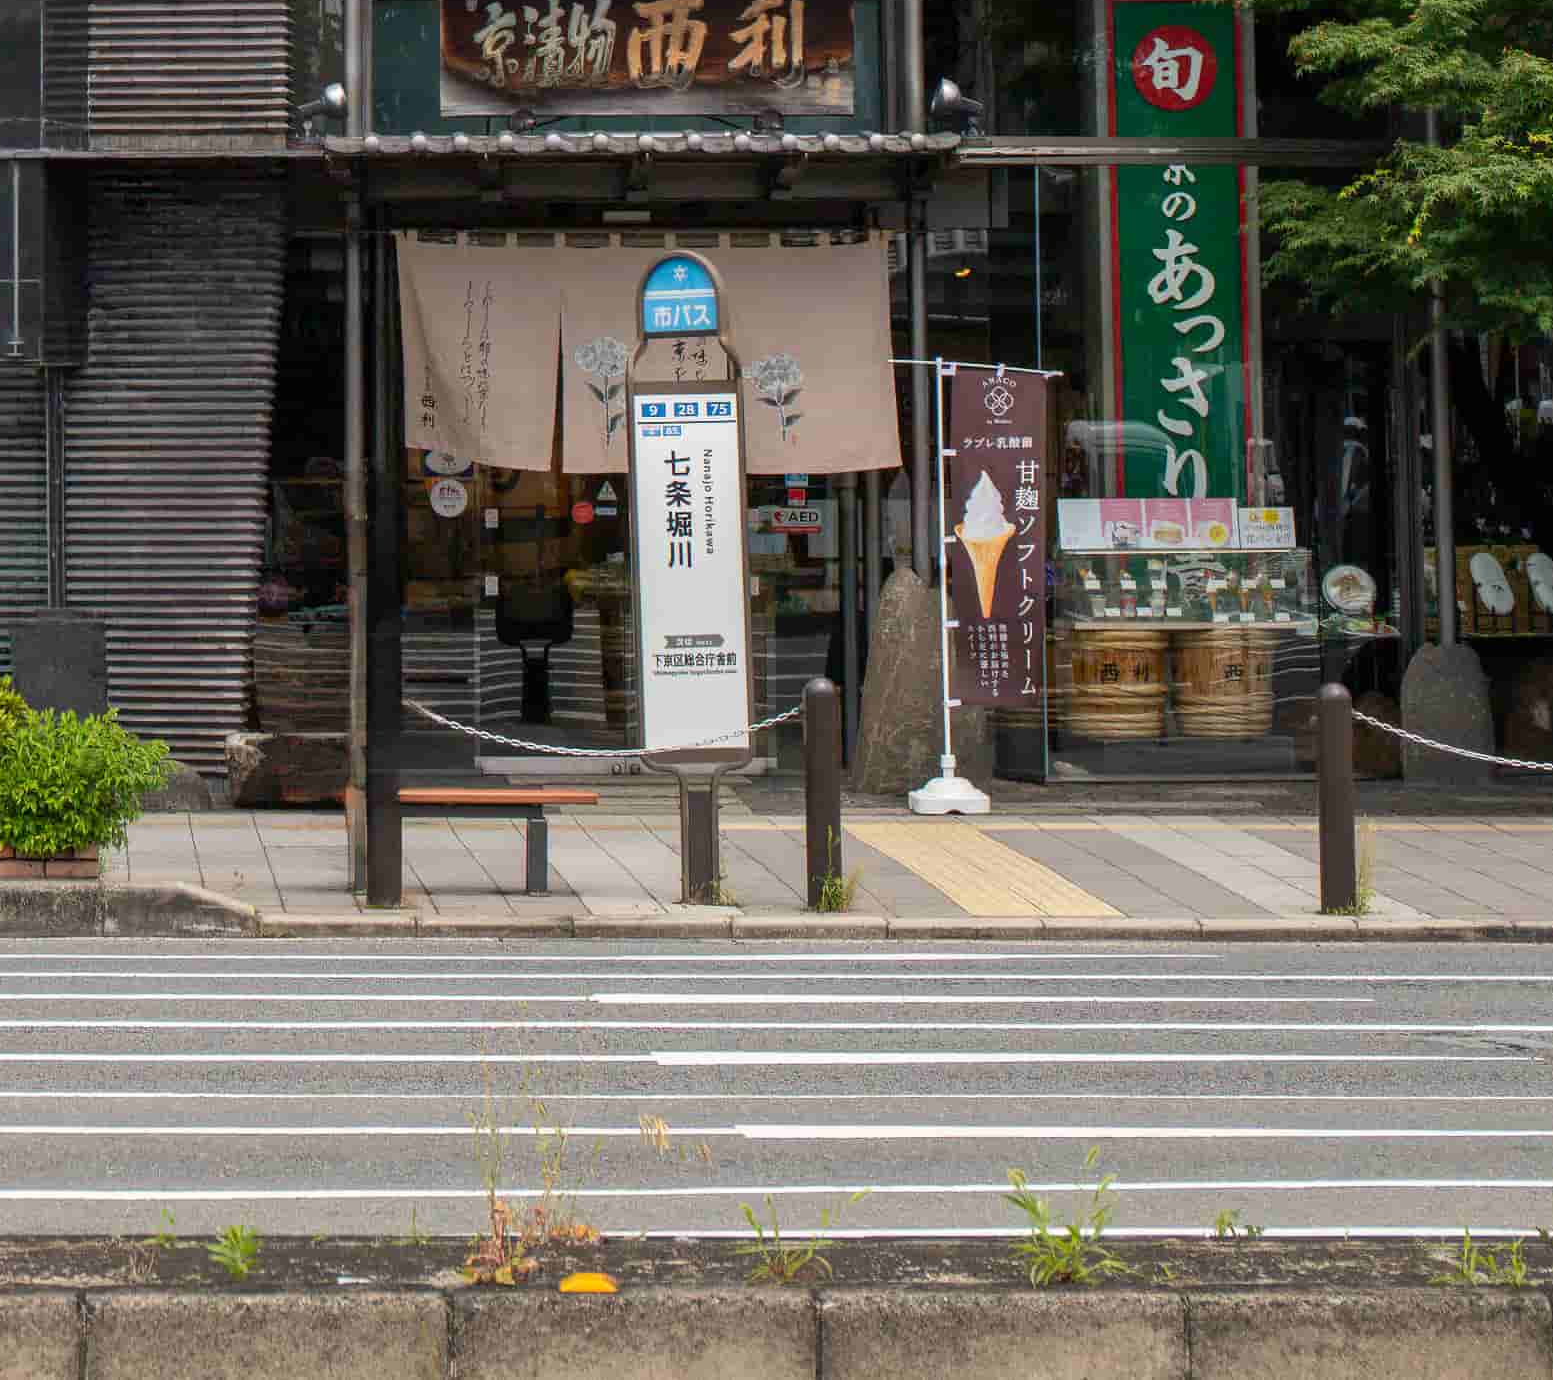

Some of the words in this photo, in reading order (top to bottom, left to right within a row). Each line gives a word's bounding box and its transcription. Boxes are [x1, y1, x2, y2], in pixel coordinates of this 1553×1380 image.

[1141, 37, 1204, 101] 旬
[655, 306, 711, 327] 市バス
[679, 404, 695, 416] 28
[711, 403, 728, 415] 75
[703, 449, 713, 493] Nanajo
[664, 450, 693, 569] 七条堀川
[704, 496, 714, 555] Horikawa
[788, 511, 819, 522] AED
